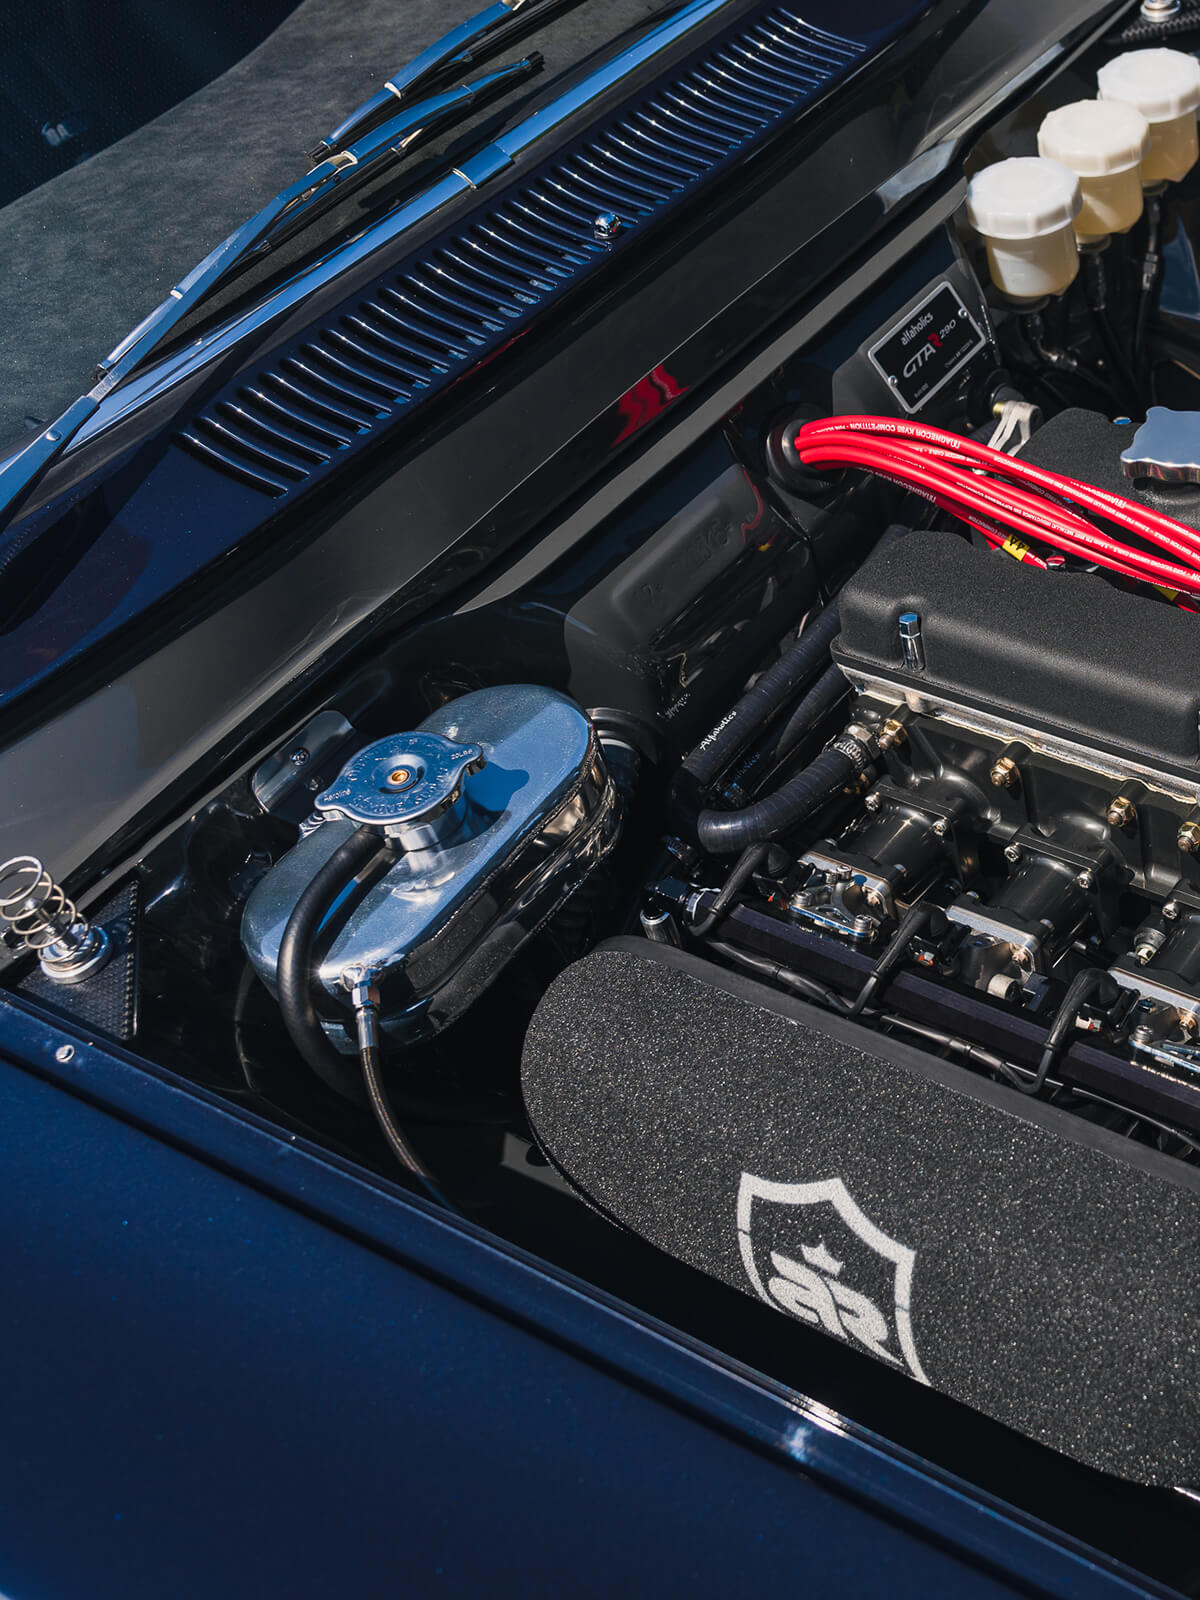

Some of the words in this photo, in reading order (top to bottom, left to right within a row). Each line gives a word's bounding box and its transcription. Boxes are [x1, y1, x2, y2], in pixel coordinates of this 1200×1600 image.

[900, 312, 934, 346] alfaholics
[939, 319, 957, 340] 290
[849, 421, 896, 432] COMPETITION
[915, 428, 960, 448] MAGNECOR
[700, 710, 737, 751] Alfaholics
